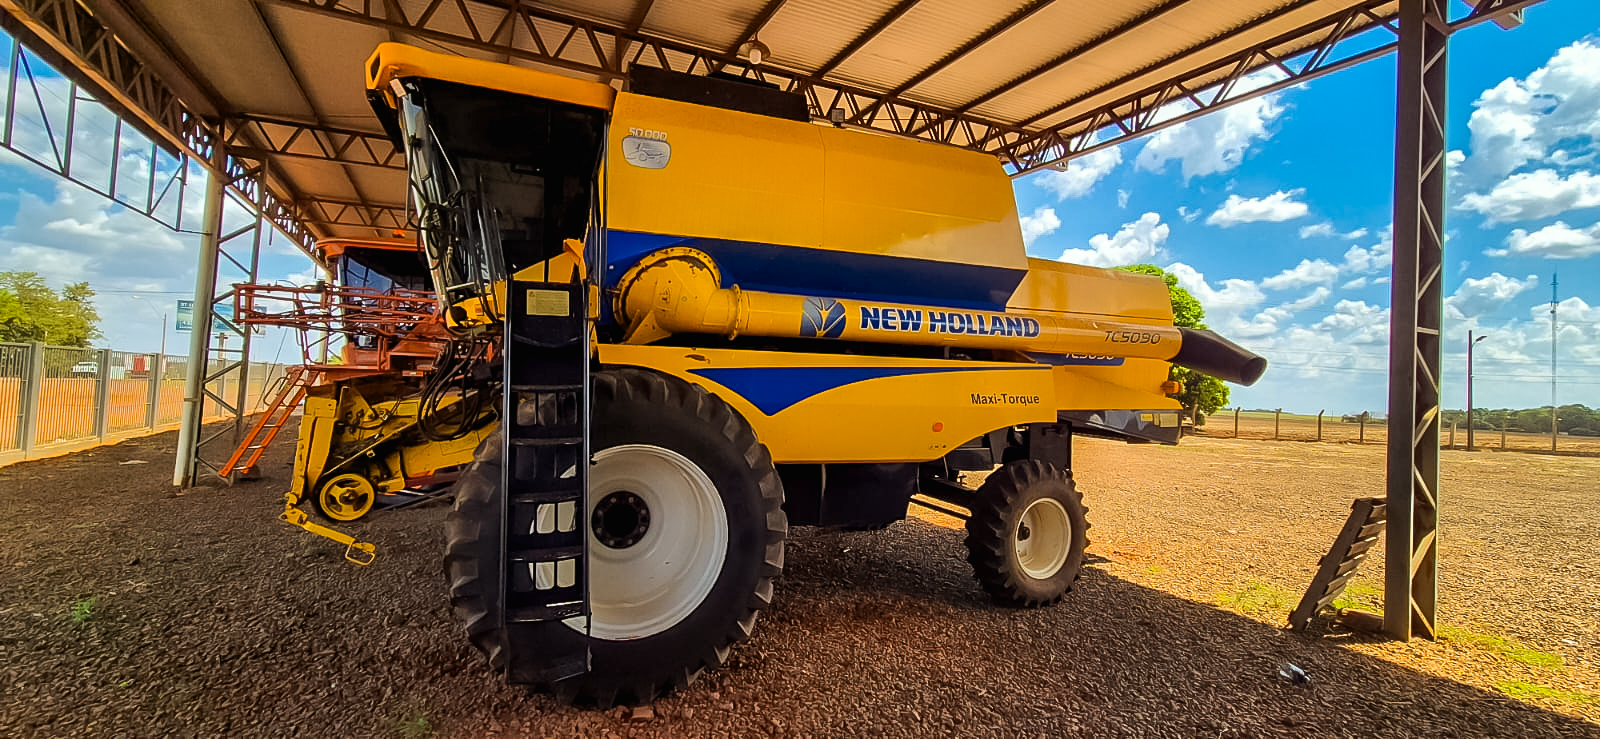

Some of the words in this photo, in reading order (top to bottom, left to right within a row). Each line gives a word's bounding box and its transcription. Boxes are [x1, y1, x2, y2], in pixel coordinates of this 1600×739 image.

[860, 305, 922, 332] NEW
[928, 310, 1040, 338] HOLLAND
[1104, 330, 1161, 345] TC5090
[970, 393, 1040, 407] Maxi-Torque
